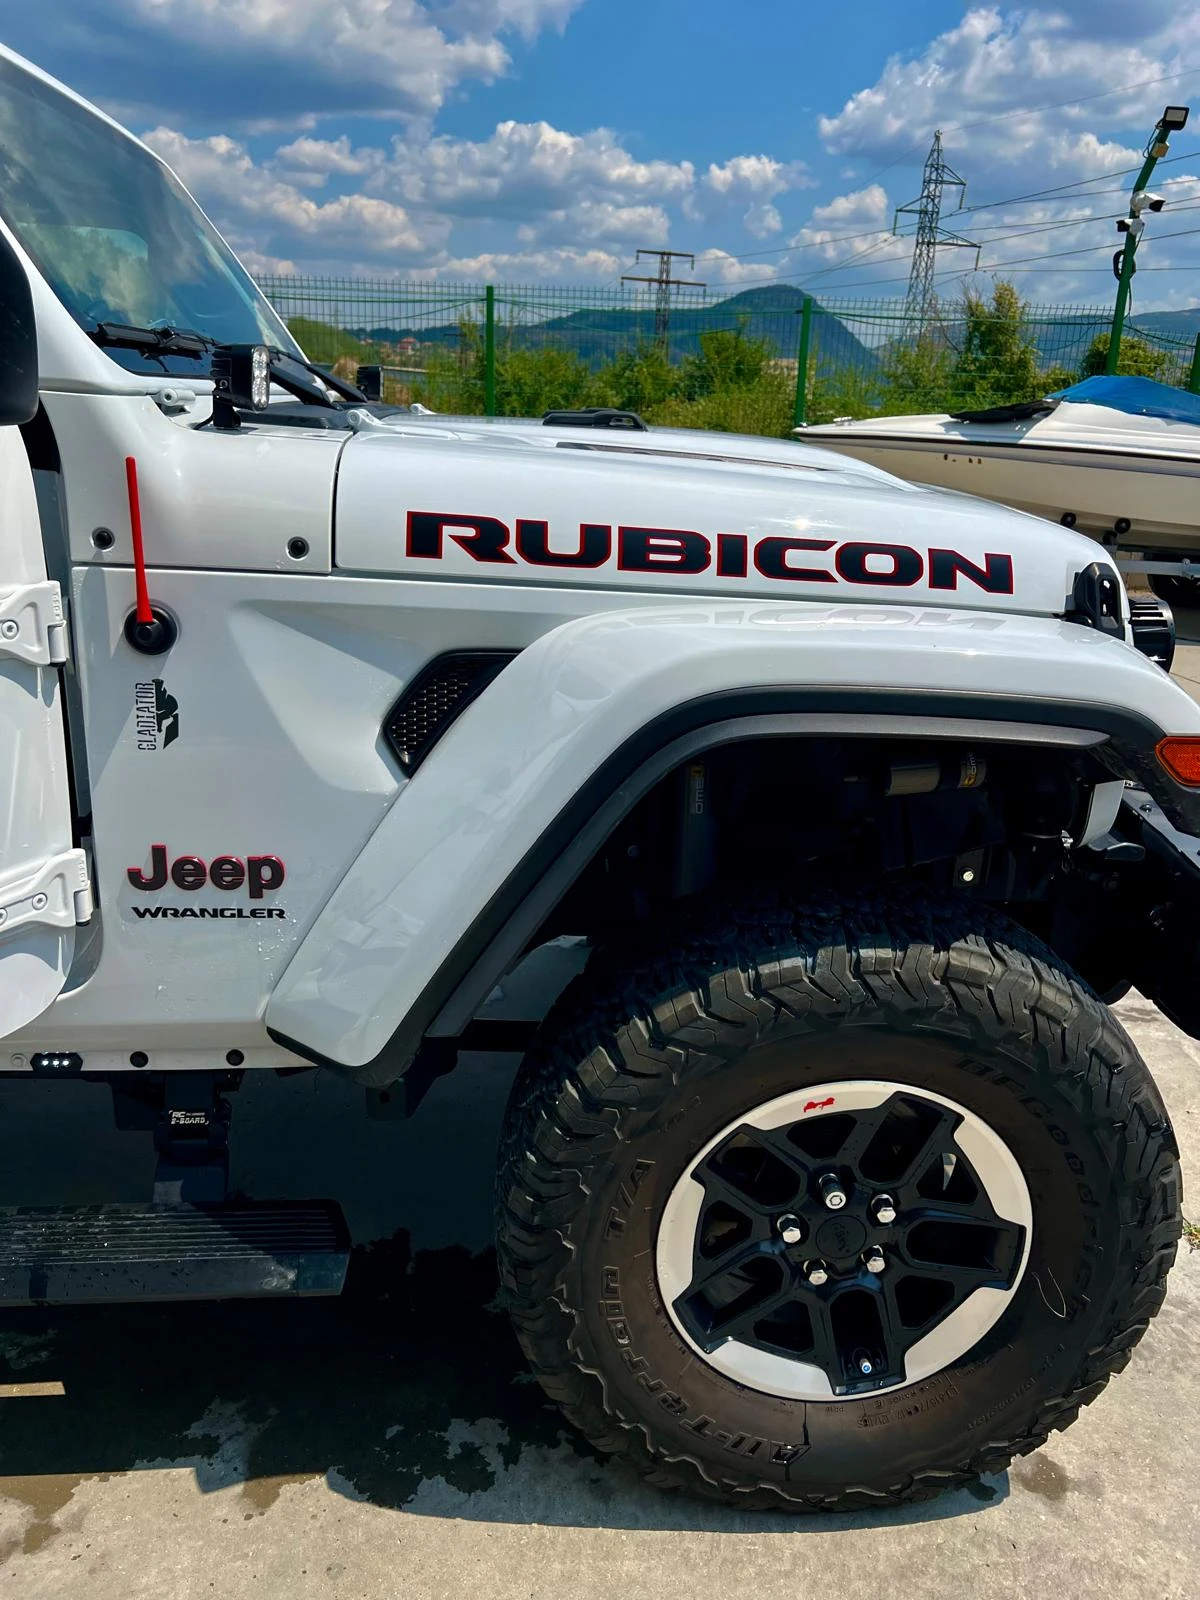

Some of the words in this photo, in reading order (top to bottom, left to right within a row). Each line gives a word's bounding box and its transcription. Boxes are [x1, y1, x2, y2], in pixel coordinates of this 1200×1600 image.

[406, 511, 1013, 594] RUBICON
[135, 682, 157, 751] GLADIATOR
[127, 844, 285, 899] Jeep
[131, 906, 286, 919] WRANGLER
[604, 1158, 656, 1242] T/A
